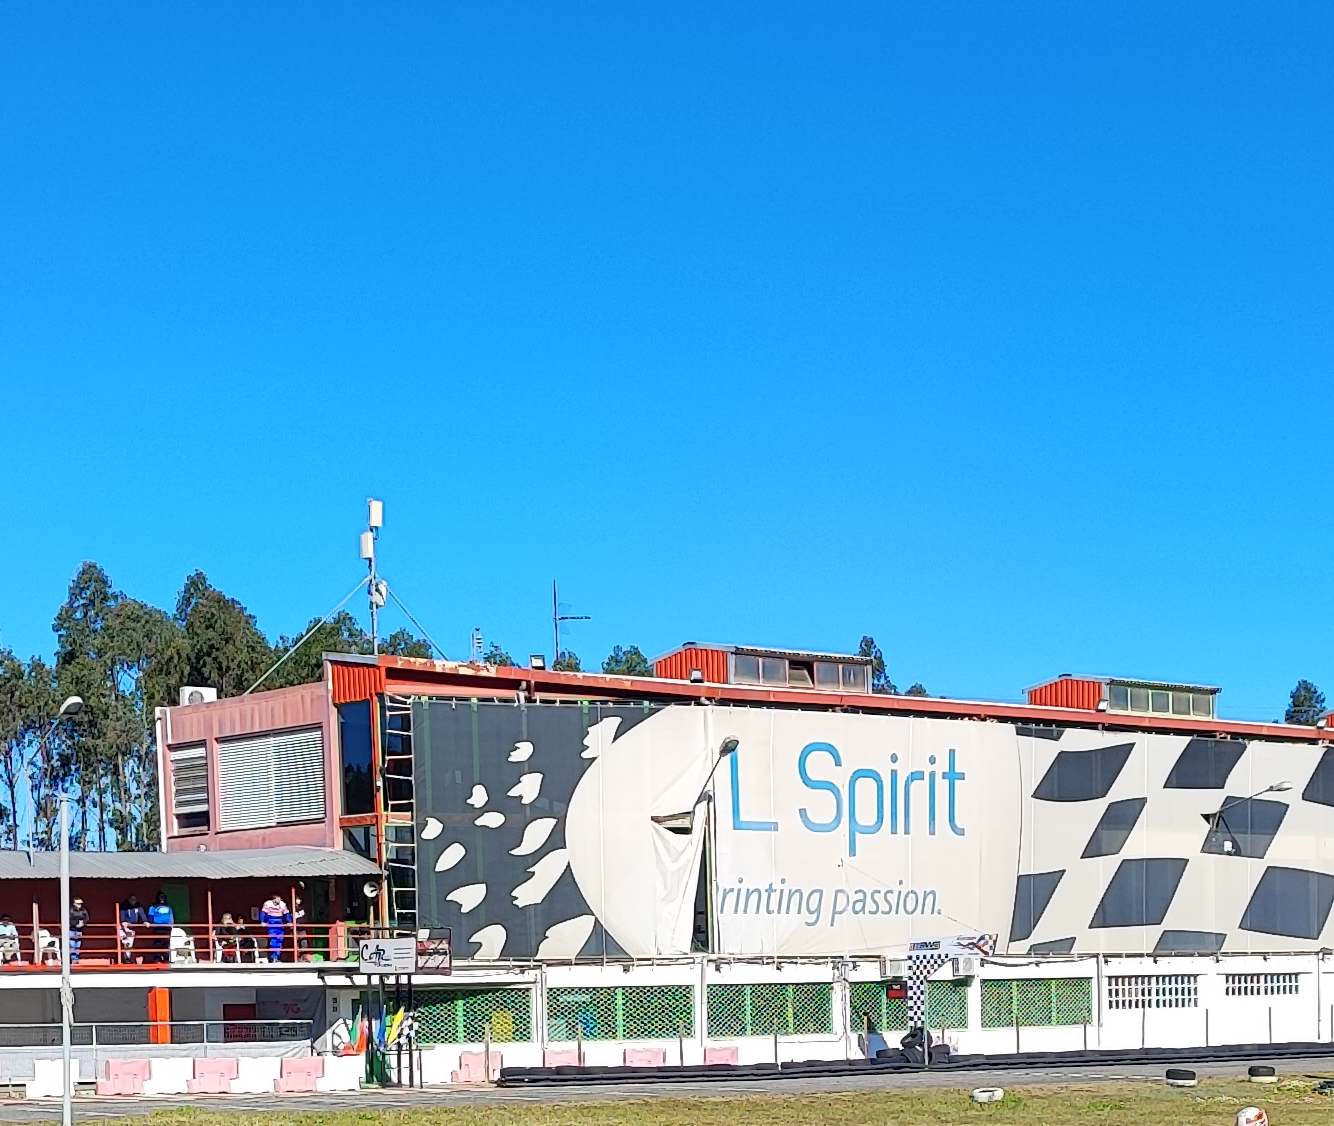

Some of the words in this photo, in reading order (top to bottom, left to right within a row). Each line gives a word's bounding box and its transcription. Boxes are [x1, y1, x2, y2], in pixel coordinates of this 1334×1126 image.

[729, 744, 779, 832] L
[798, 741, 966, 858] Spirit
[717, 876, 824, 927] rinting
[829, 879, 943, 927] passion.
